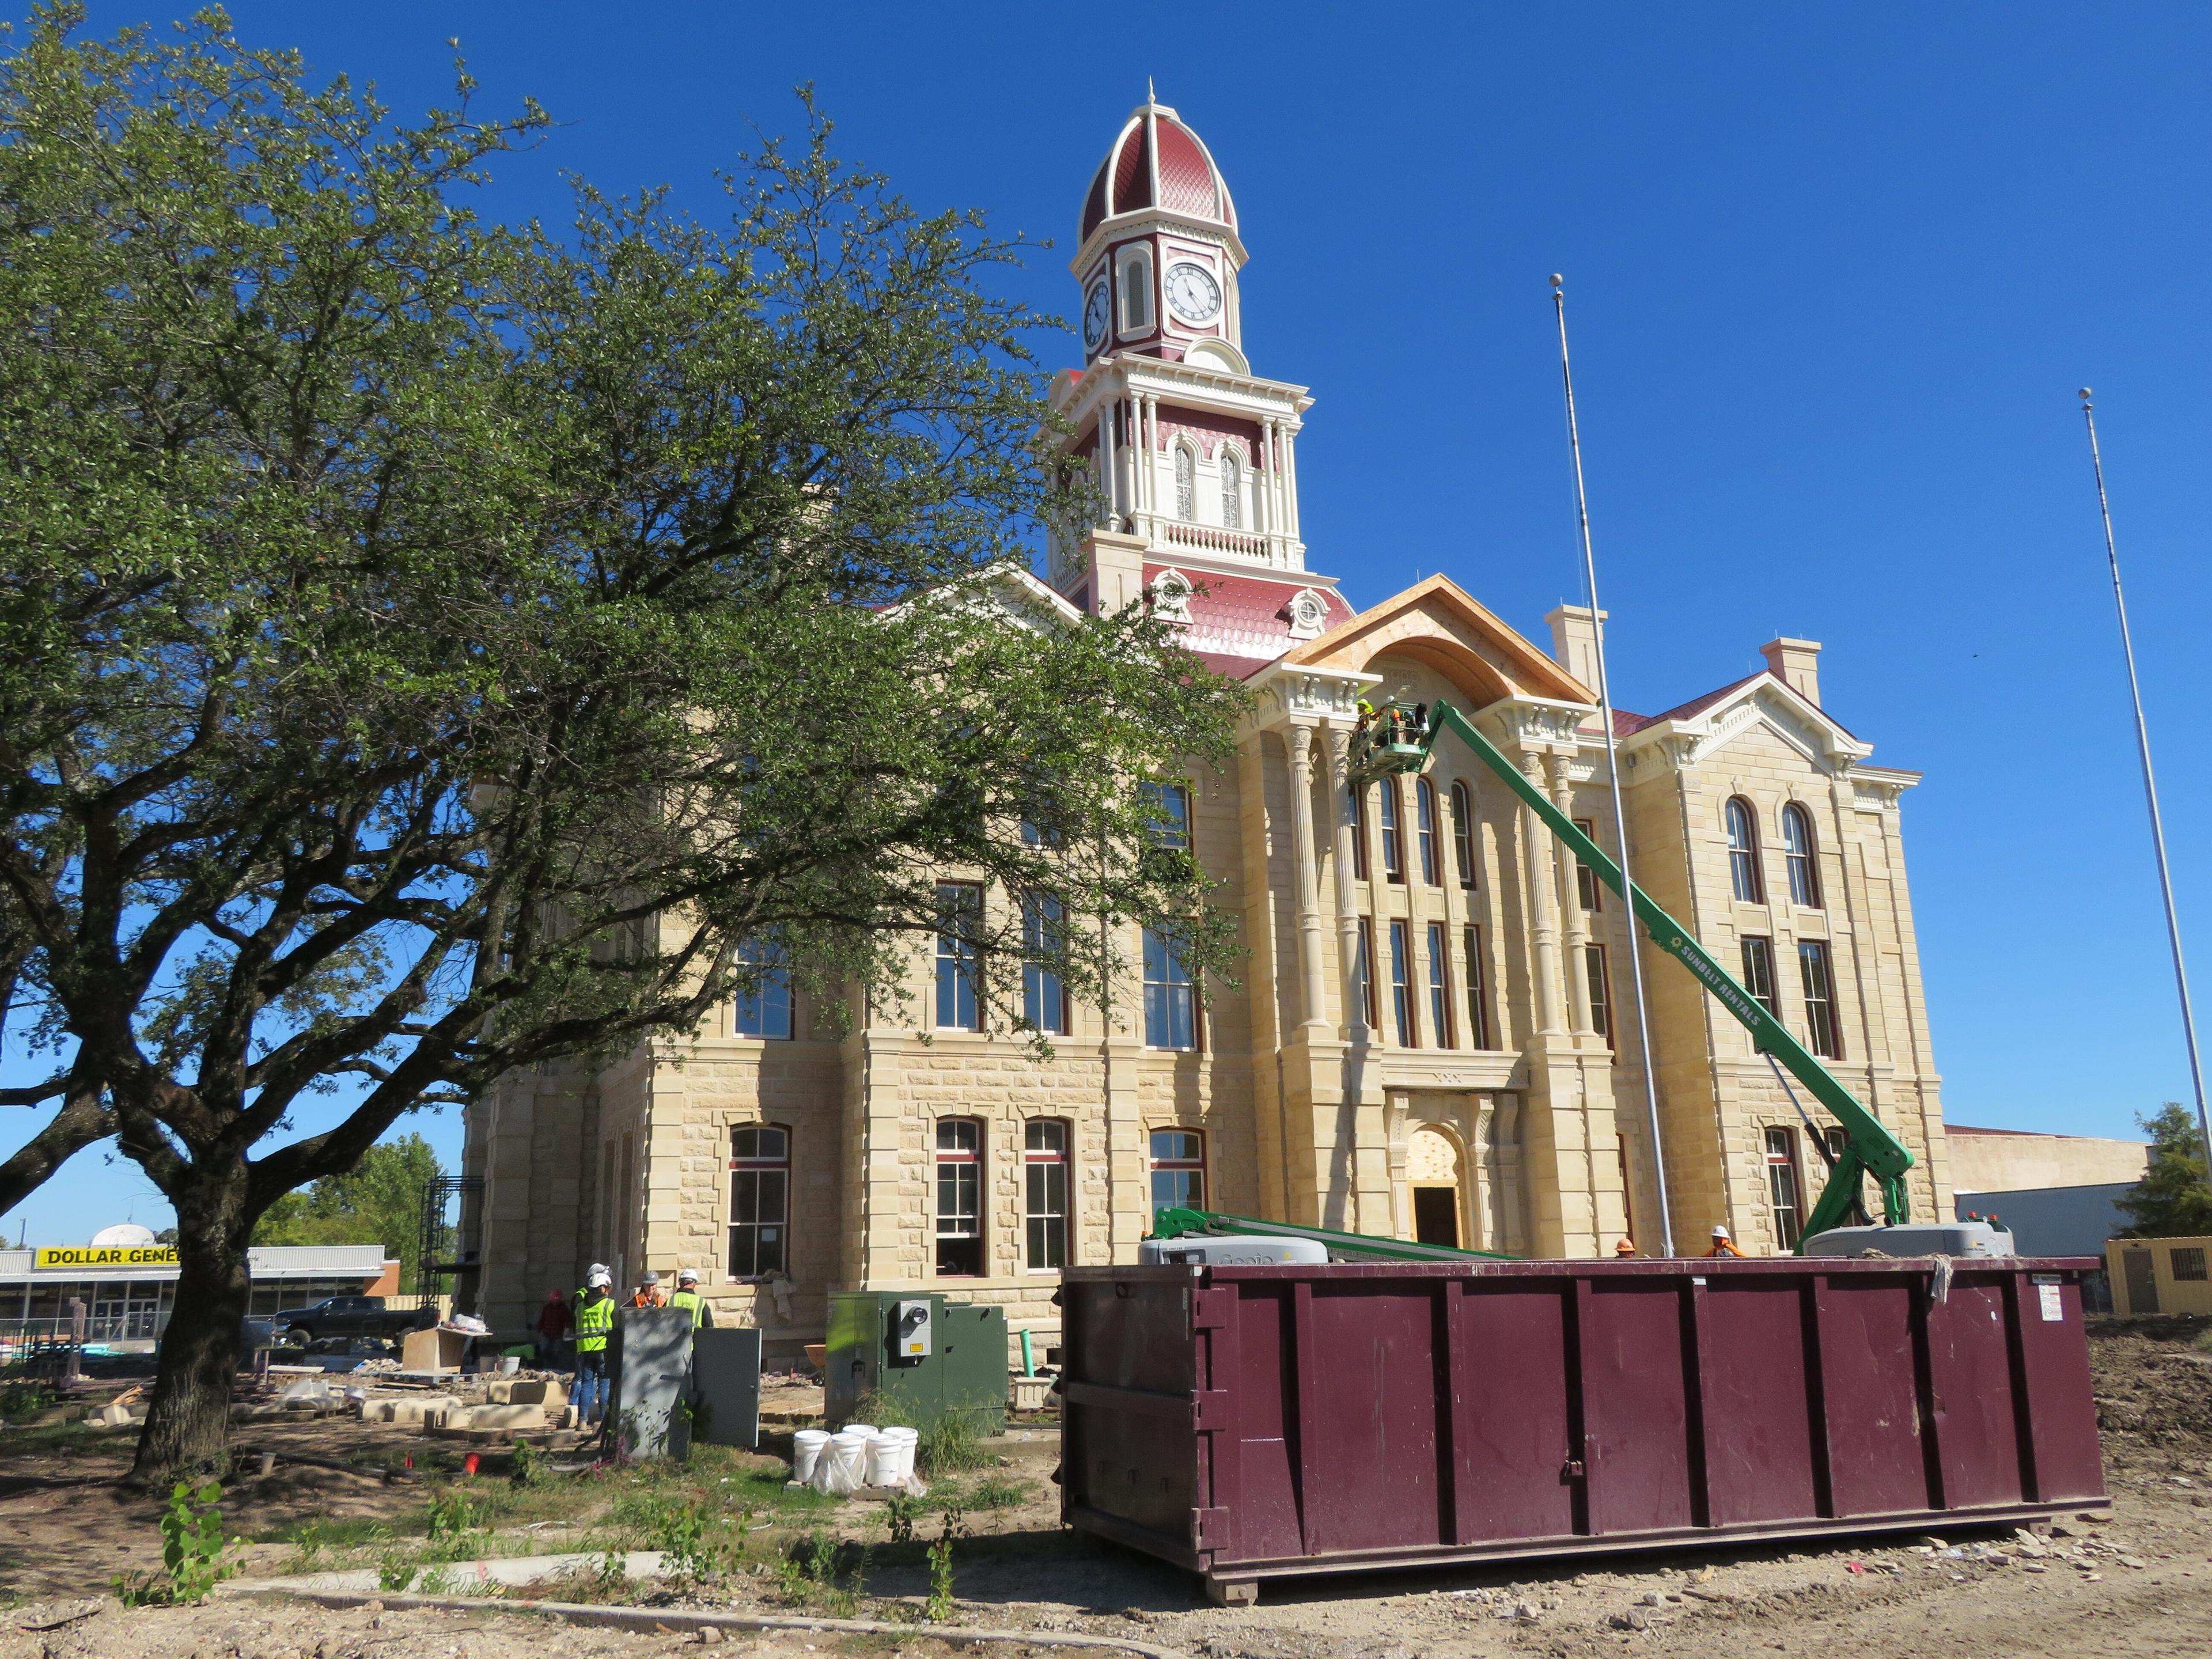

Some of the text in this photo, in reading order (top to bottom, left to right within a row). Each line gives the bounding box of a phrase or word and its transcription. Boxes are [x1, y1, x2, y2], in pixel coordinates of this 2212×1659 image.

[1681, 945, 1761, 1025] SUNBELT RENTALS
[47, 1250, 122, 1264] DOLLAR
